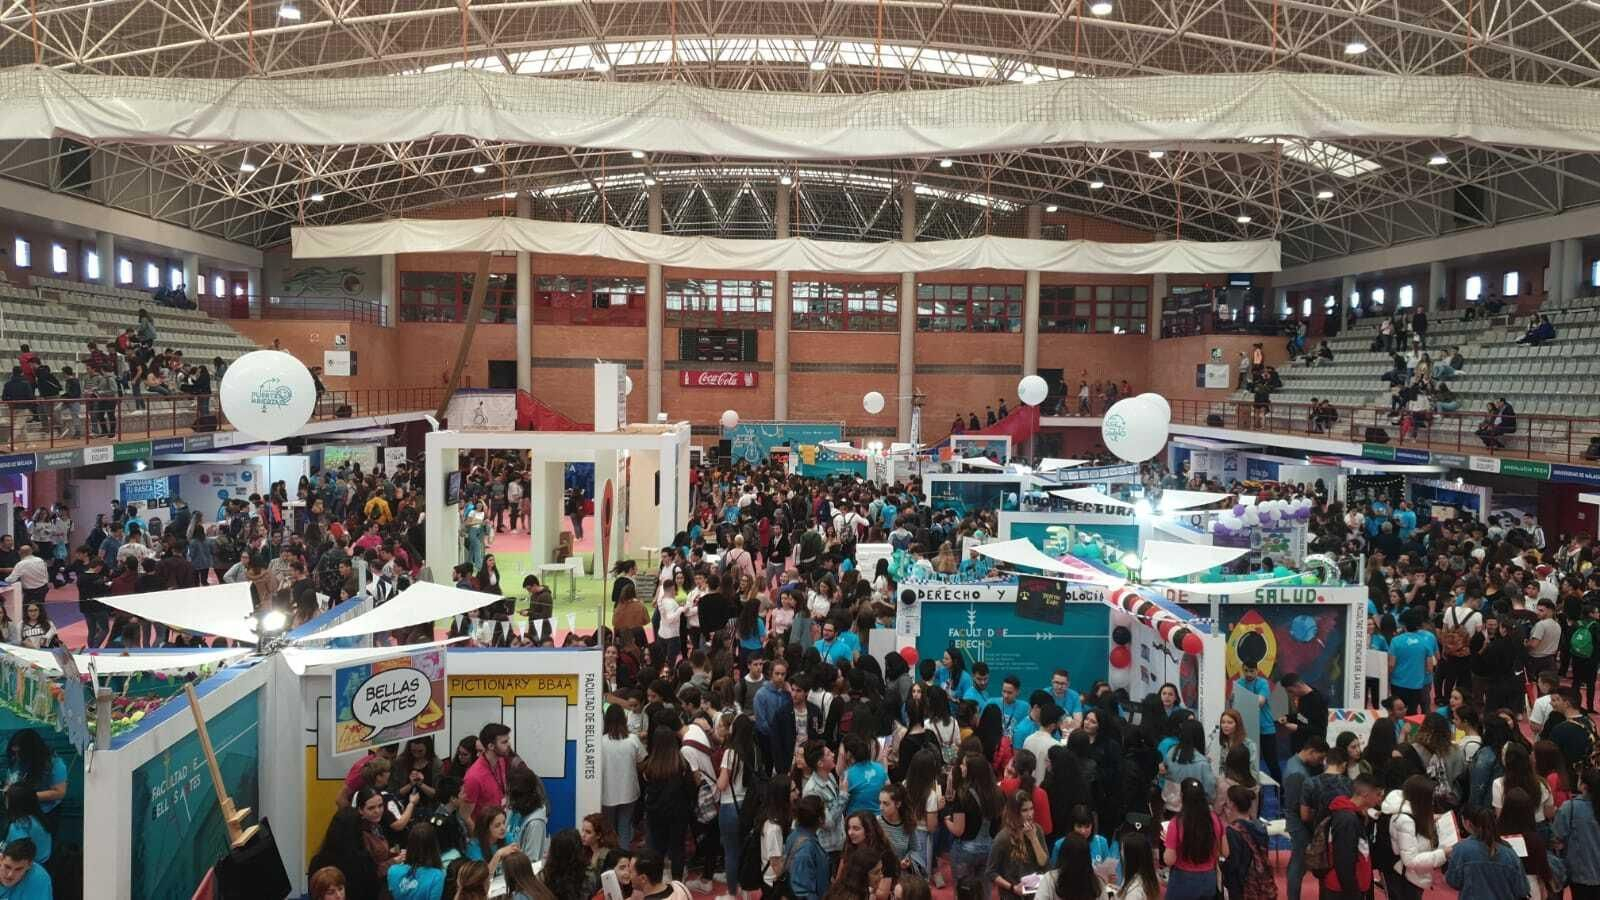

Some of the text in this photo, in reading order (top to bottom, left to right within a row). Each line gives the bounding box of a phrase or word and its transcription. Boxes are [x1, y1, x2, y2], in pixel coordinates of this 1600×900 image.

[918, 589, 980, 600] DERECHO
[997, 590, 1006, 600] Y
[366, 678, 420, 701] BELLAS
[451, 678, 572, 692] PICTIONARY BBAA
[370, 694, 417, 717] ARTES
[584, 673, 595, 780] FACULTAD DE BELLAS ARTES
